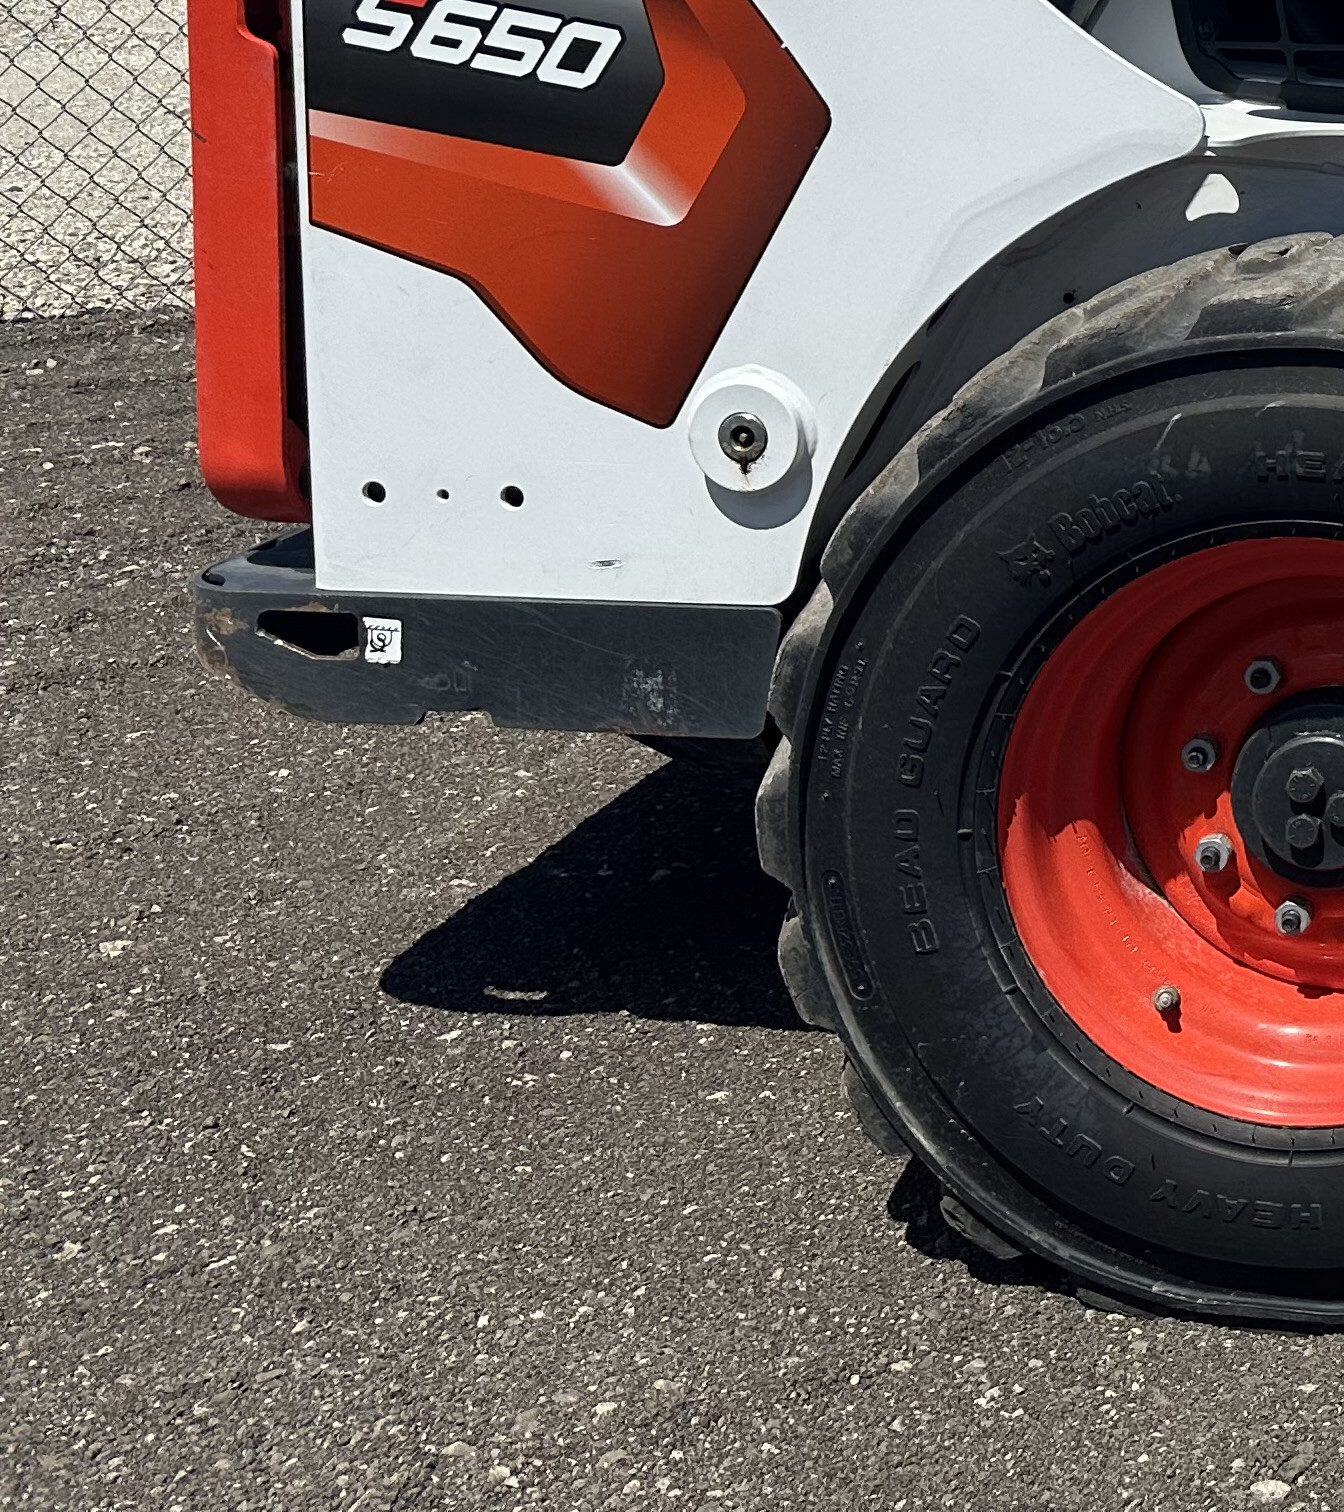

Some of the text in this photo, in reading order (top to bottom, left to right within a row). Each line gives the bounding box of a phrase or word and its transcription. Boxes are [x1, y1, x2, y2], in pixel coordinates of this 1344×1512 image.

[1048, 476, 1184, 556] Bobcat
[893, 614, 981, 956] BEAD GUARD
[1013, 1094, 1324, 1232] HEAVY DUTY
